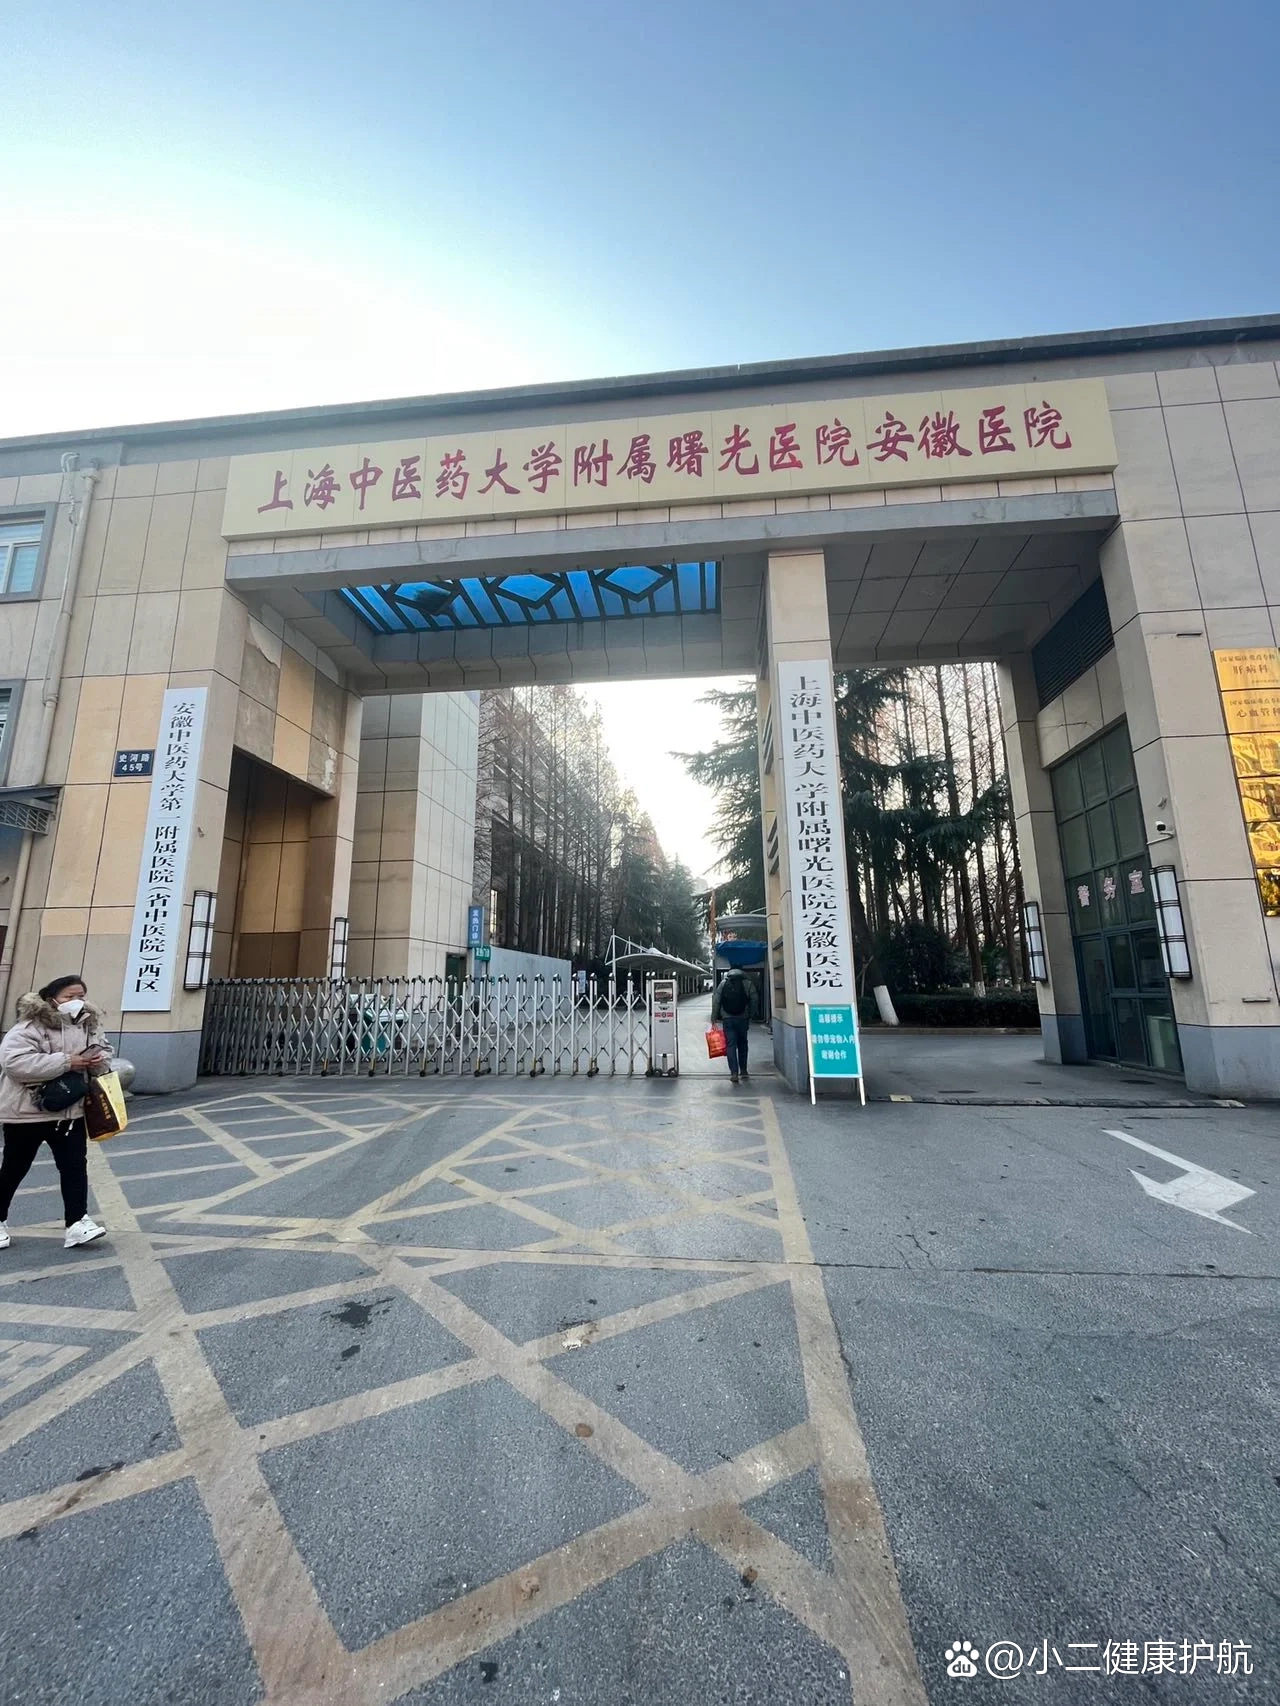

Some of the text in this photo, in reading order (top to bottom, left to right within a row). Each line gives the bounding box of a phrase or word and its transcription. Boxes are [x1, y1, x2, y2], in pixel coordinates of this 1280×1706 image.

[257, 400, 1073, 513] 上海中医药大学附属曙光医院安徽医院
[118, 753, 150, 763] 史河路
[121, 762, 144, 772] 45号
[786, 675, 845, 989] 上海中医药大学附属曙光医院安徽医院
[1076, 869, 1146, 908] 警务室
